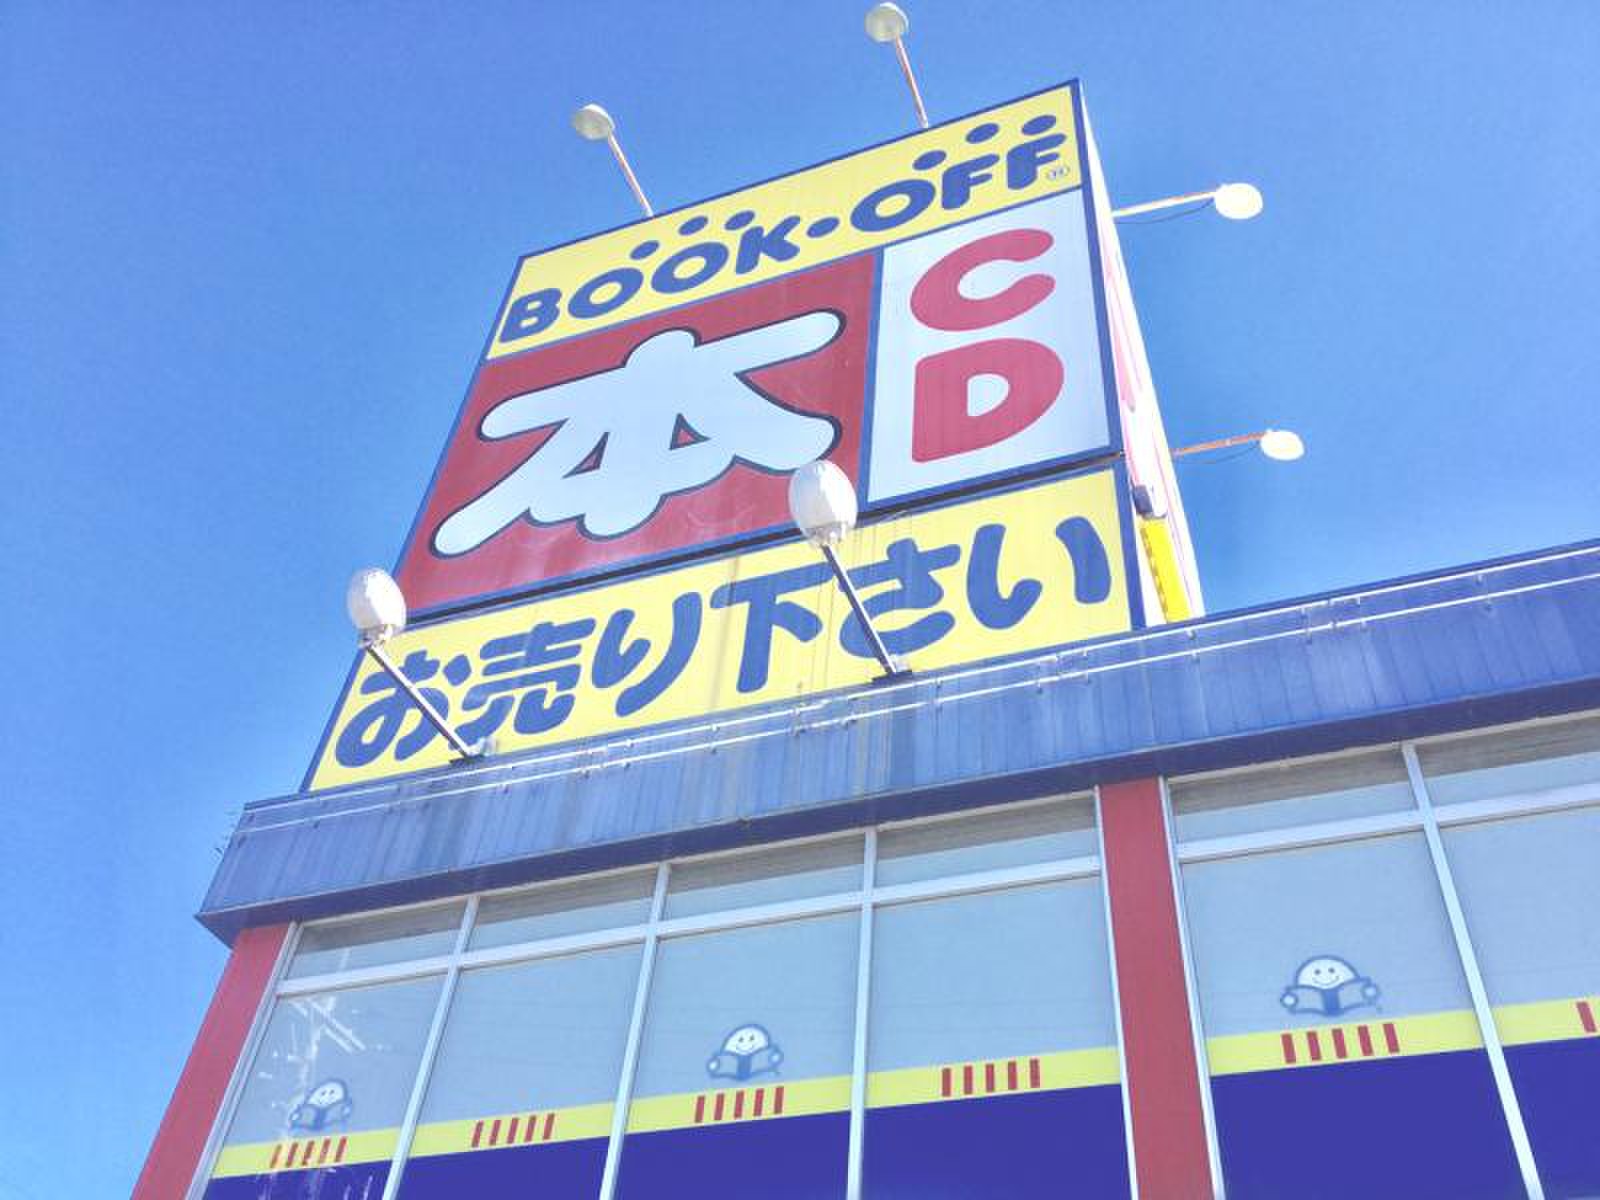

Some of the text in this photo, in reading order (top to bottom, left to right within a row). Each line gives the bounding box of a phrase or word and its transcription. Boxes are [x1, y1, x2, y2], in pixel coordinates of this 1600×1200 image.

[430, 309, 846, 558] 本
[910, 228, 1065, 463] CD
[335, 516, 1112, 768] お売り下さい
